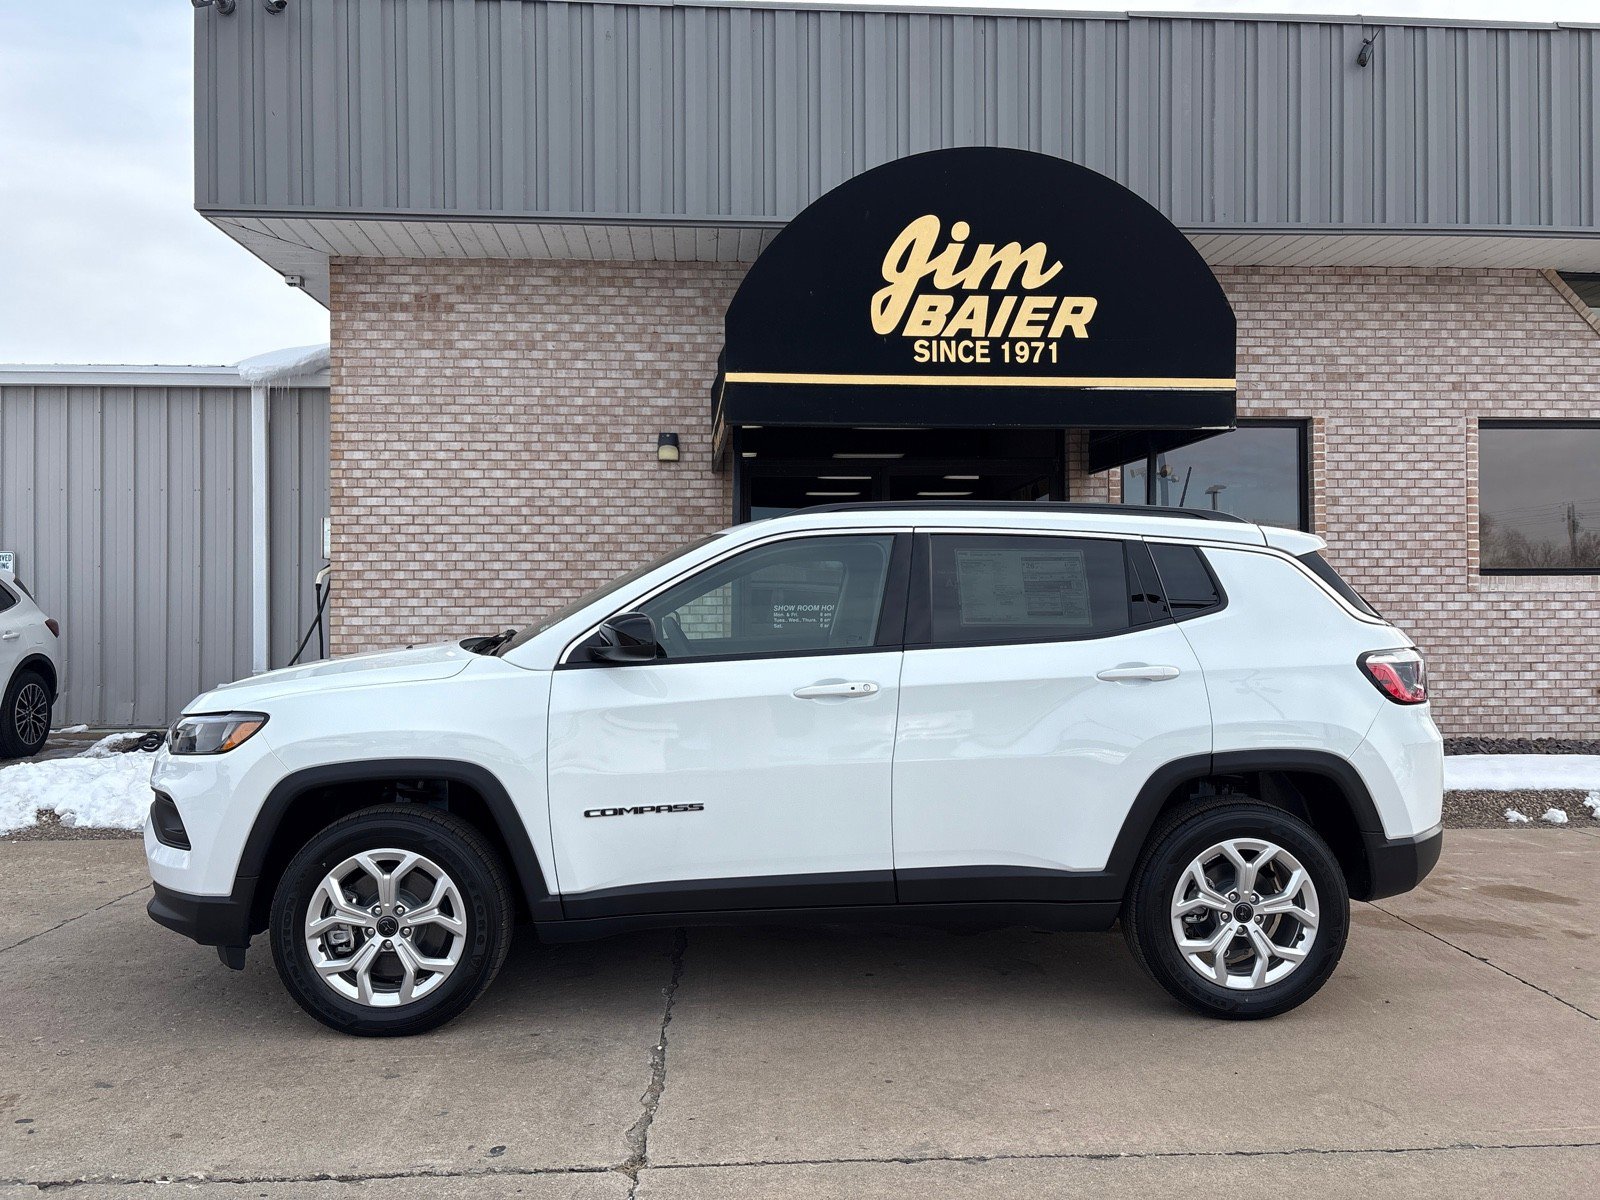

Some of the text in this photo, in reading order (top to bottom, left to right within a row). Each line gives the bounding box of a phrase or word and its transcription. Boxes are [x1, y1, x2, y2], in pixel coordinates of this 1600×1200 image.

[870, 214, 1064, 335] Jim
[902, 294, 1098, 338] BAIER
[913, 340, 1058, 363] SINCE 1971
[583, 802, 704, 818] COMPASS
